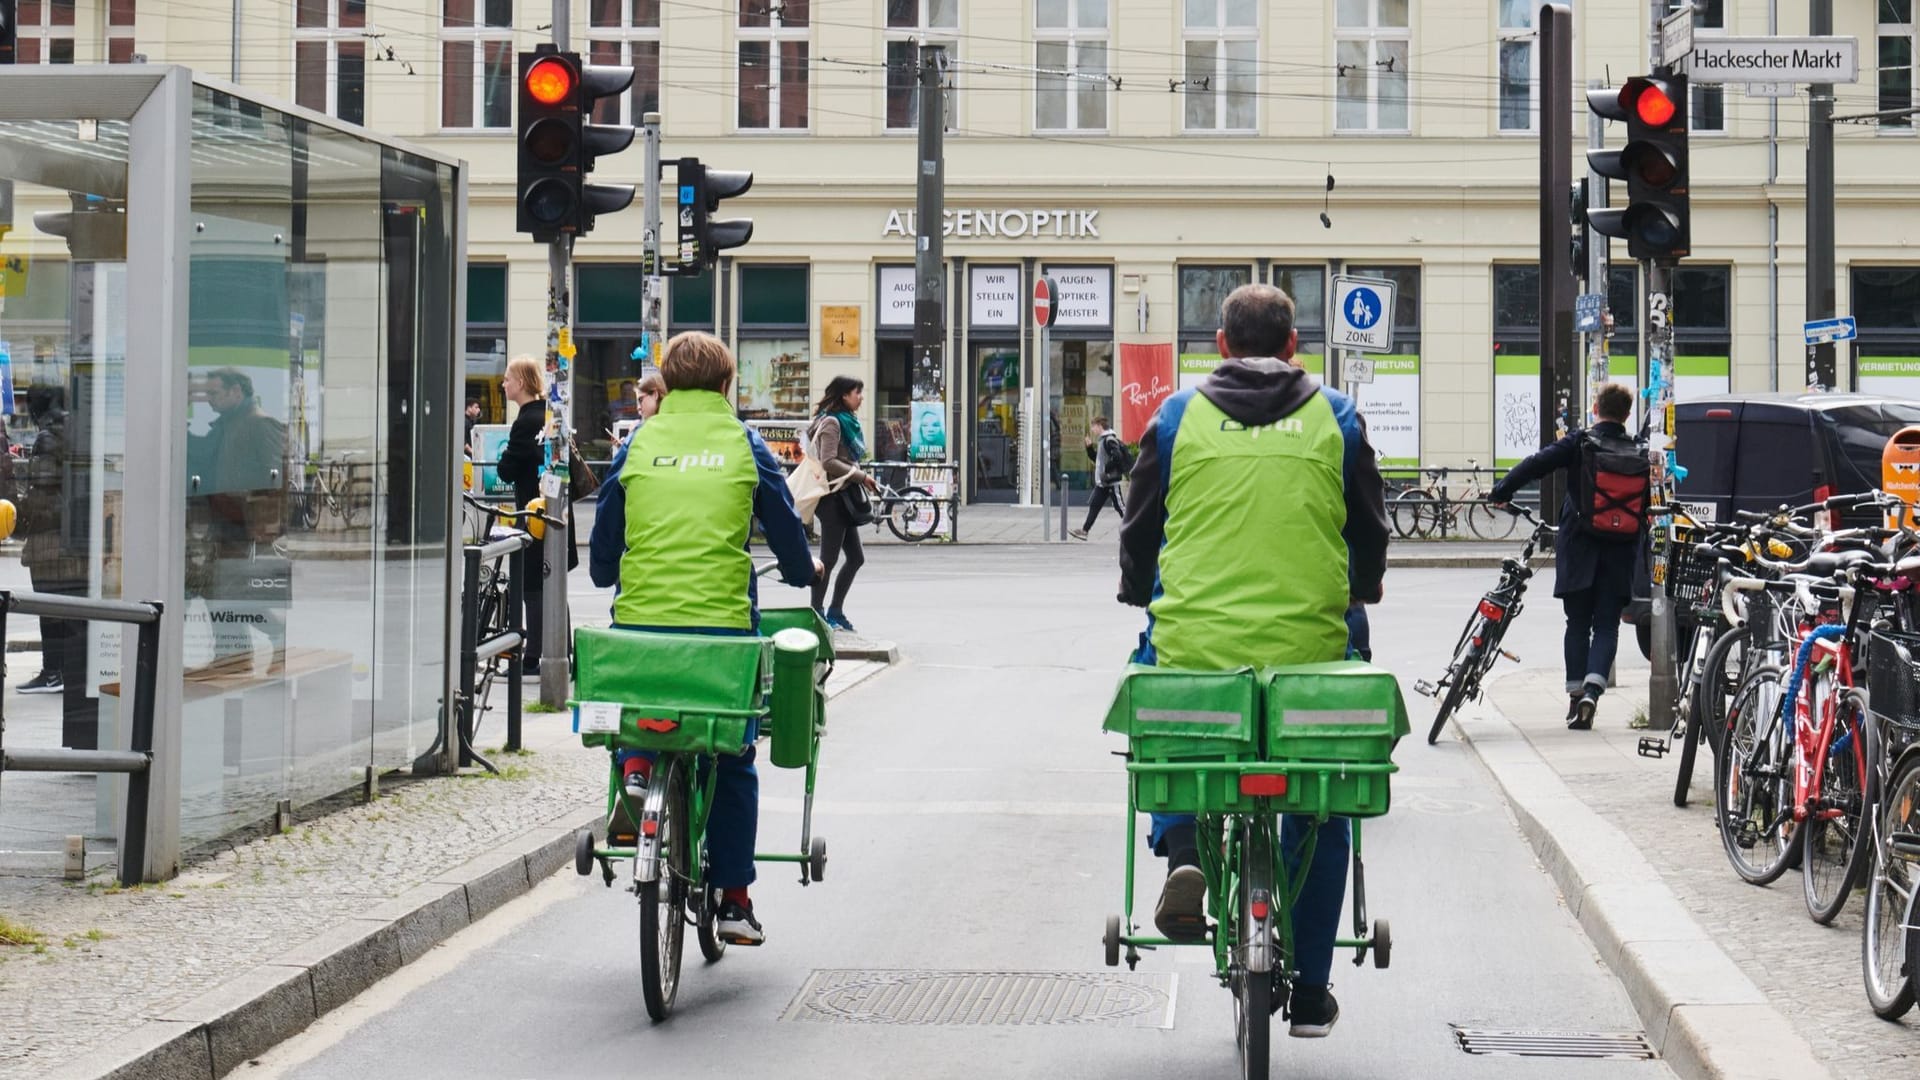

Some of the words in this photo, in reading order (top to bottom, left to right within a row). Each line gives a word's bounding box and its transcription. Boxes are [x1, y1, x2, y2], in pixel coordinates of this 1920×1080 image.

[1694, 49, 1788, 69] Hackescher
[1791, 49, 1842, 69] Markt
[986, 275, 1005, 284] WIR
[1060, 276, 1096, 285] AUGEN-
[976, 292, 1014, 301] STELLEN
[1058, 292, 1099, 301] OPTIKER-
[987, 309, 1003, 318] EIN
[1059, 309, 1098, 318] MEISTER
[834, 331, 846, 347] 4
[1345, 331, 1375, 344] ZONE
[1121, 376, 1171, 406] Ray-Ban
[679, 449, 725, 473] pin
[210, 610, 268, 624] Wärme.
